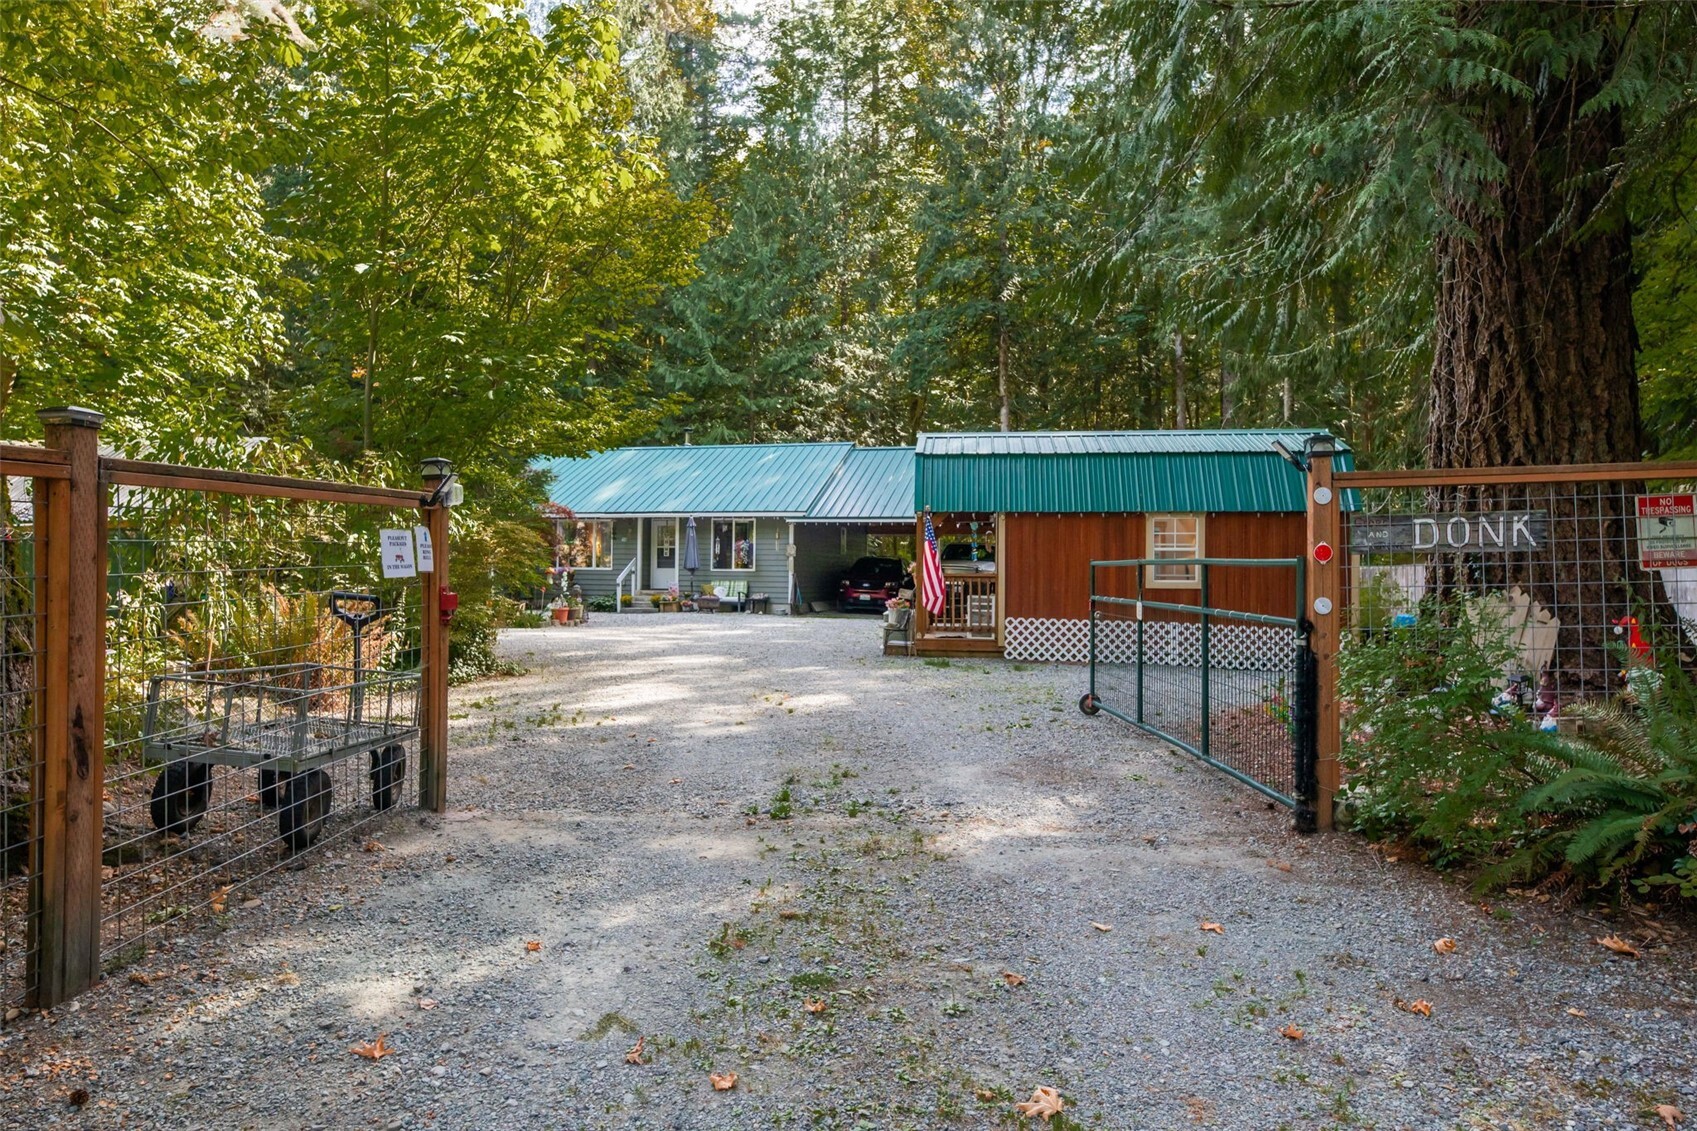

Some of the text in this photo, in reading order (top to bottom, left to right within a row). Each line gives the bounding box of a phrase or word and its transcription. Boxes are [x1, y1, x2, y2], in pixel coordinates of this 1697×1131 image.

[1641, 505, 1691, 514] TRESPASSING
[1368, 530, 1389, 538] AND
[1411, 515, 1537, 549] DONK
[1653, 550, 1686, 559] BEWARE
